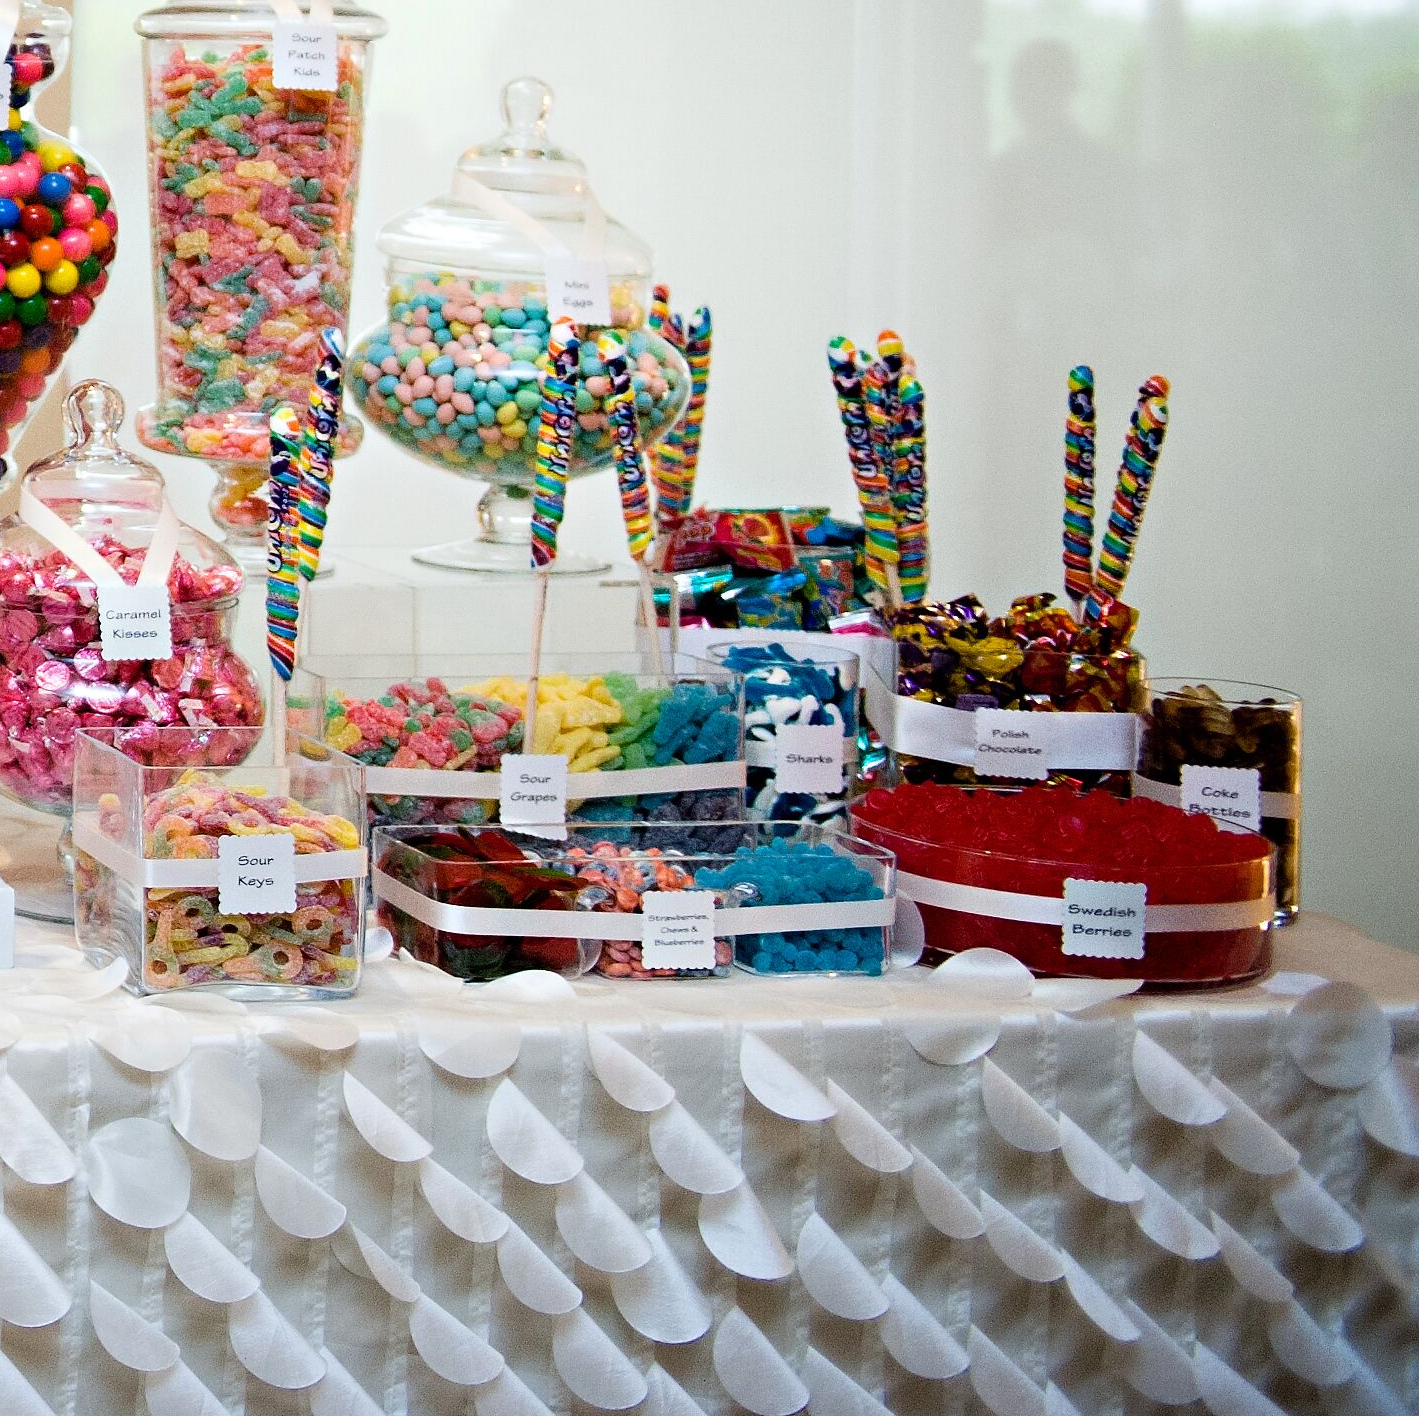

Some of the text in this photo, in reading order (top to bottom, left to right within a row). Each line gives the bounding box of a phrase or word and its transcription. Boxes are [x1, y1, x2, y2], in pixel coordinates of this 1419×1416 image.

[291, 32, 322, 43] Sour
[288, 50, 325, 60] Patch
[106, 608, 162, 620] Caramel
[112, 628, 158, 639] Kisses
[992, 729, 1030, 739] Polish
[978, 744, 1043, 755] Chocolate
[786, 753, 834, 764] Sharks
[519, 773, 552, 784] Sour
[510, 791, 558, 805] Grapes
[1201, 786, 1239, 799] Coke
[237, 855, 274, 866] Sour
[238, 875, 274, 889] Keys
[1068, 903, 1137, 918] Swedish
[1072, 924, 1133, 937] Berries
